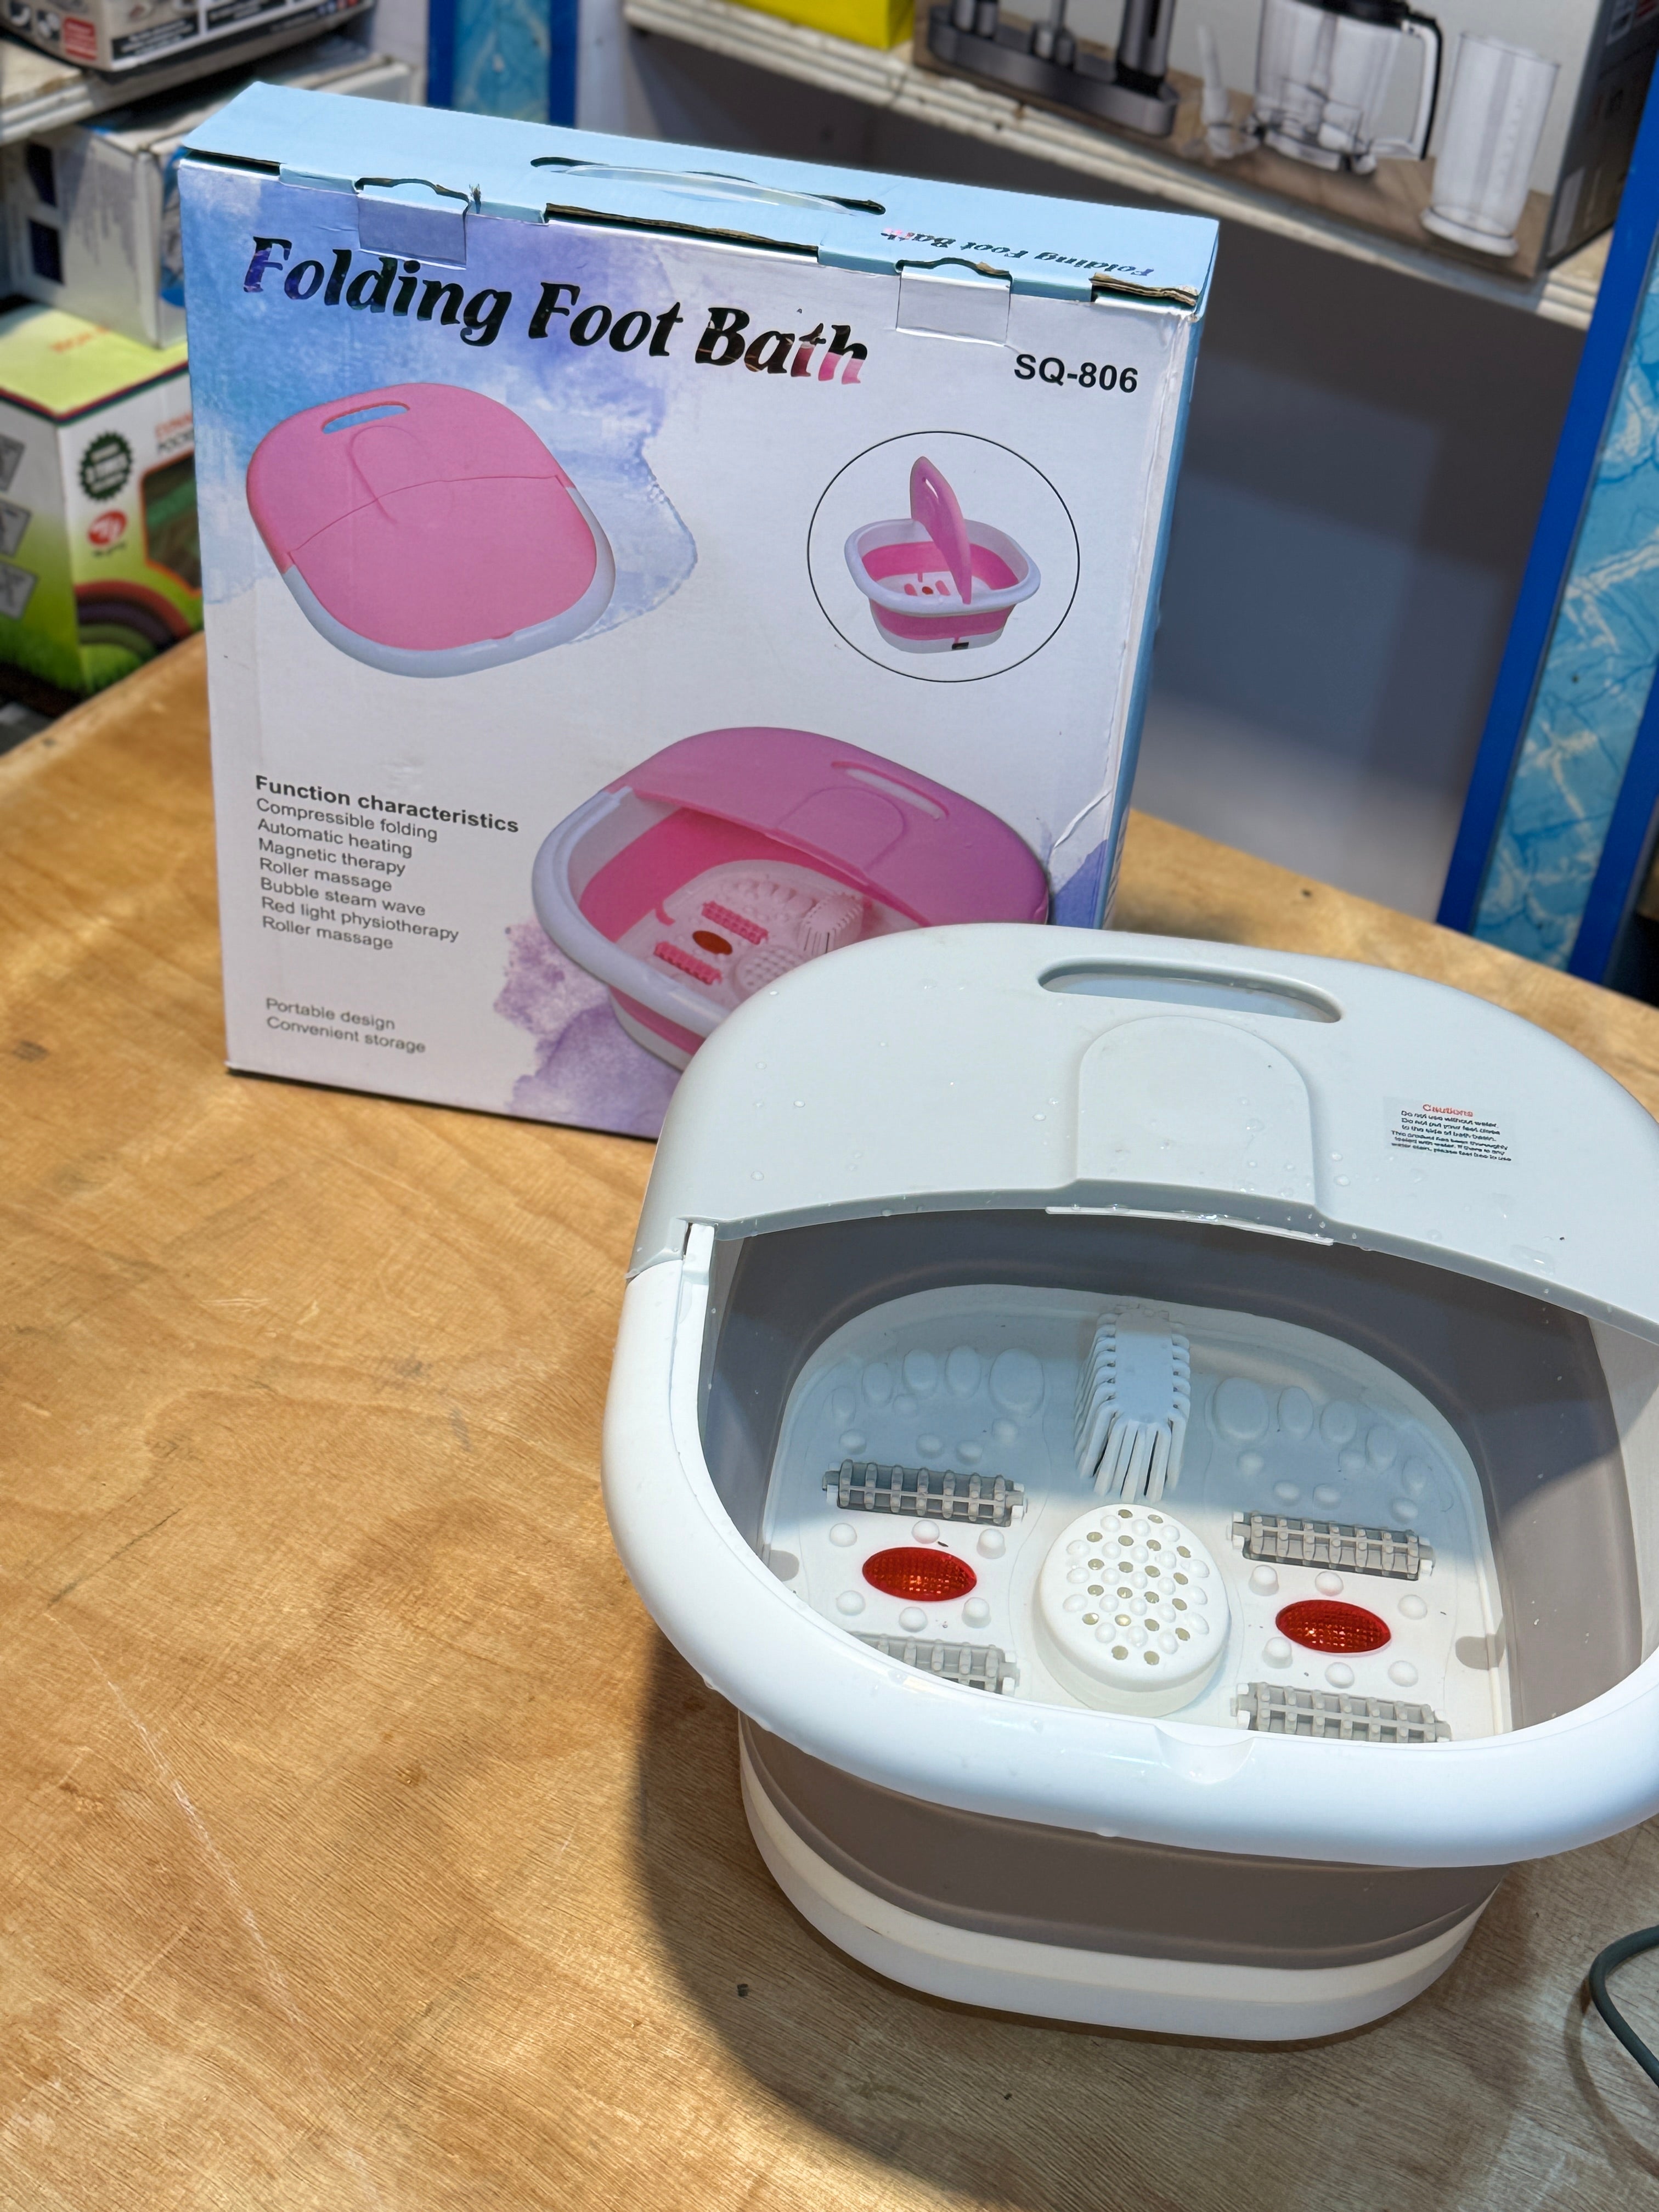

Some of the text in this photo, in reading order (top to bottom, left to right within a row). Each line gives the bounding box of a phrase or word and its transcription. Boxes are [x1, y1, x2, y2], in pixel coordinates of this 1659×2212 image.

[881, 228, 1154, 276] Folding Foot Bath
[244, 236, 868, 385] Folding Foot Bath
[1014, 353, 1138, 393] SQ-806
[255, 775, 519, 833] Function characteristics
[256, 797, 438, 843] Compressible folding
[258, 818, 413, 859] Automatic heating
[259, 838, 406, 877] Magnetic therapy
[260, 857, 392, 893] Roller massage
[261, 877, 426, 916] Bubble steam wave
[262, 896, 459, 943] Red light physiotherapy
[262, 915, 393, 950] Roller massage
[266, 997, 395, 1031] Portable design
[267, 1016, 426, 1054] Convenient storage
[1423, 1104, 1474, 1117] Cautions
